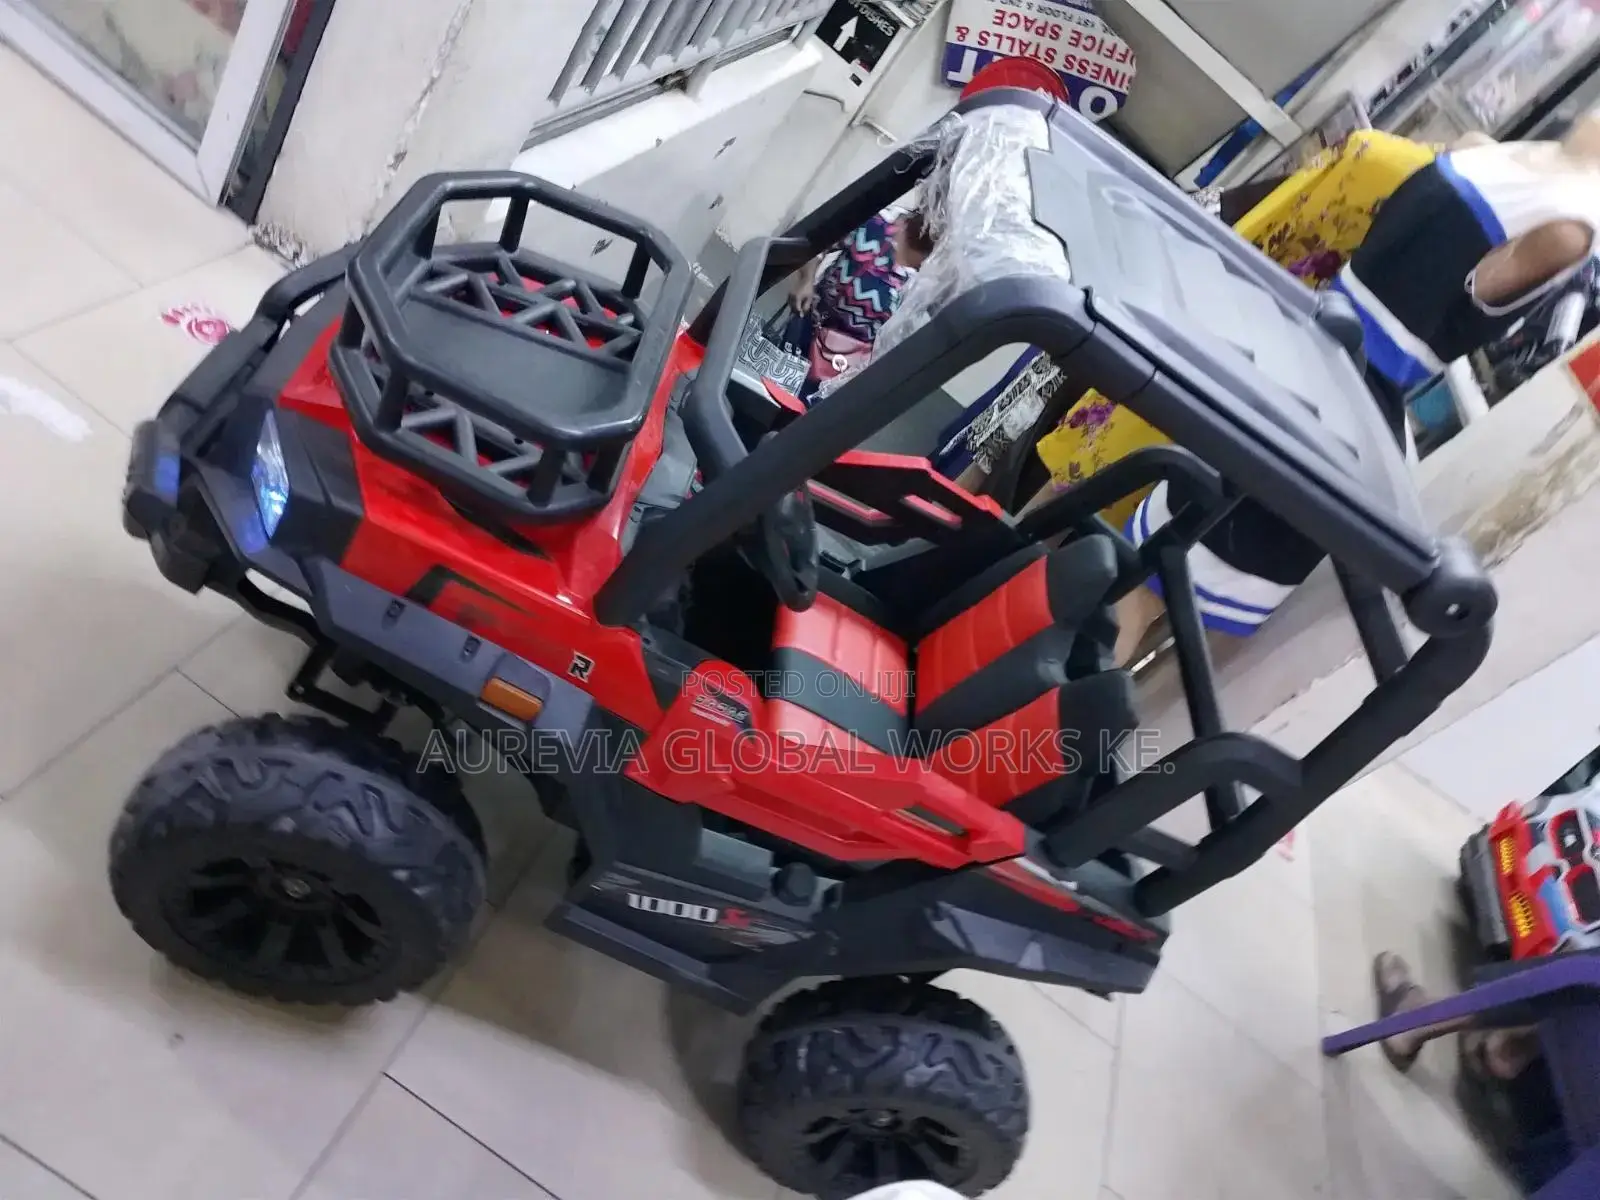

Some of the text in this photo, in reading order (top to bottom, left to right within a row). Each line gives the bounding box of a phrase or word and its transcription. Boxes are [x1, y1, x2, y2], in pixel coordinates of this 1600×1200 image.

[992, 9, 1062, 41] SPACE
[1036, 5, 1073, 22] FLOOR
[955, 26, 969, 42] &
[977, 30, 1057, 64] STALLS
